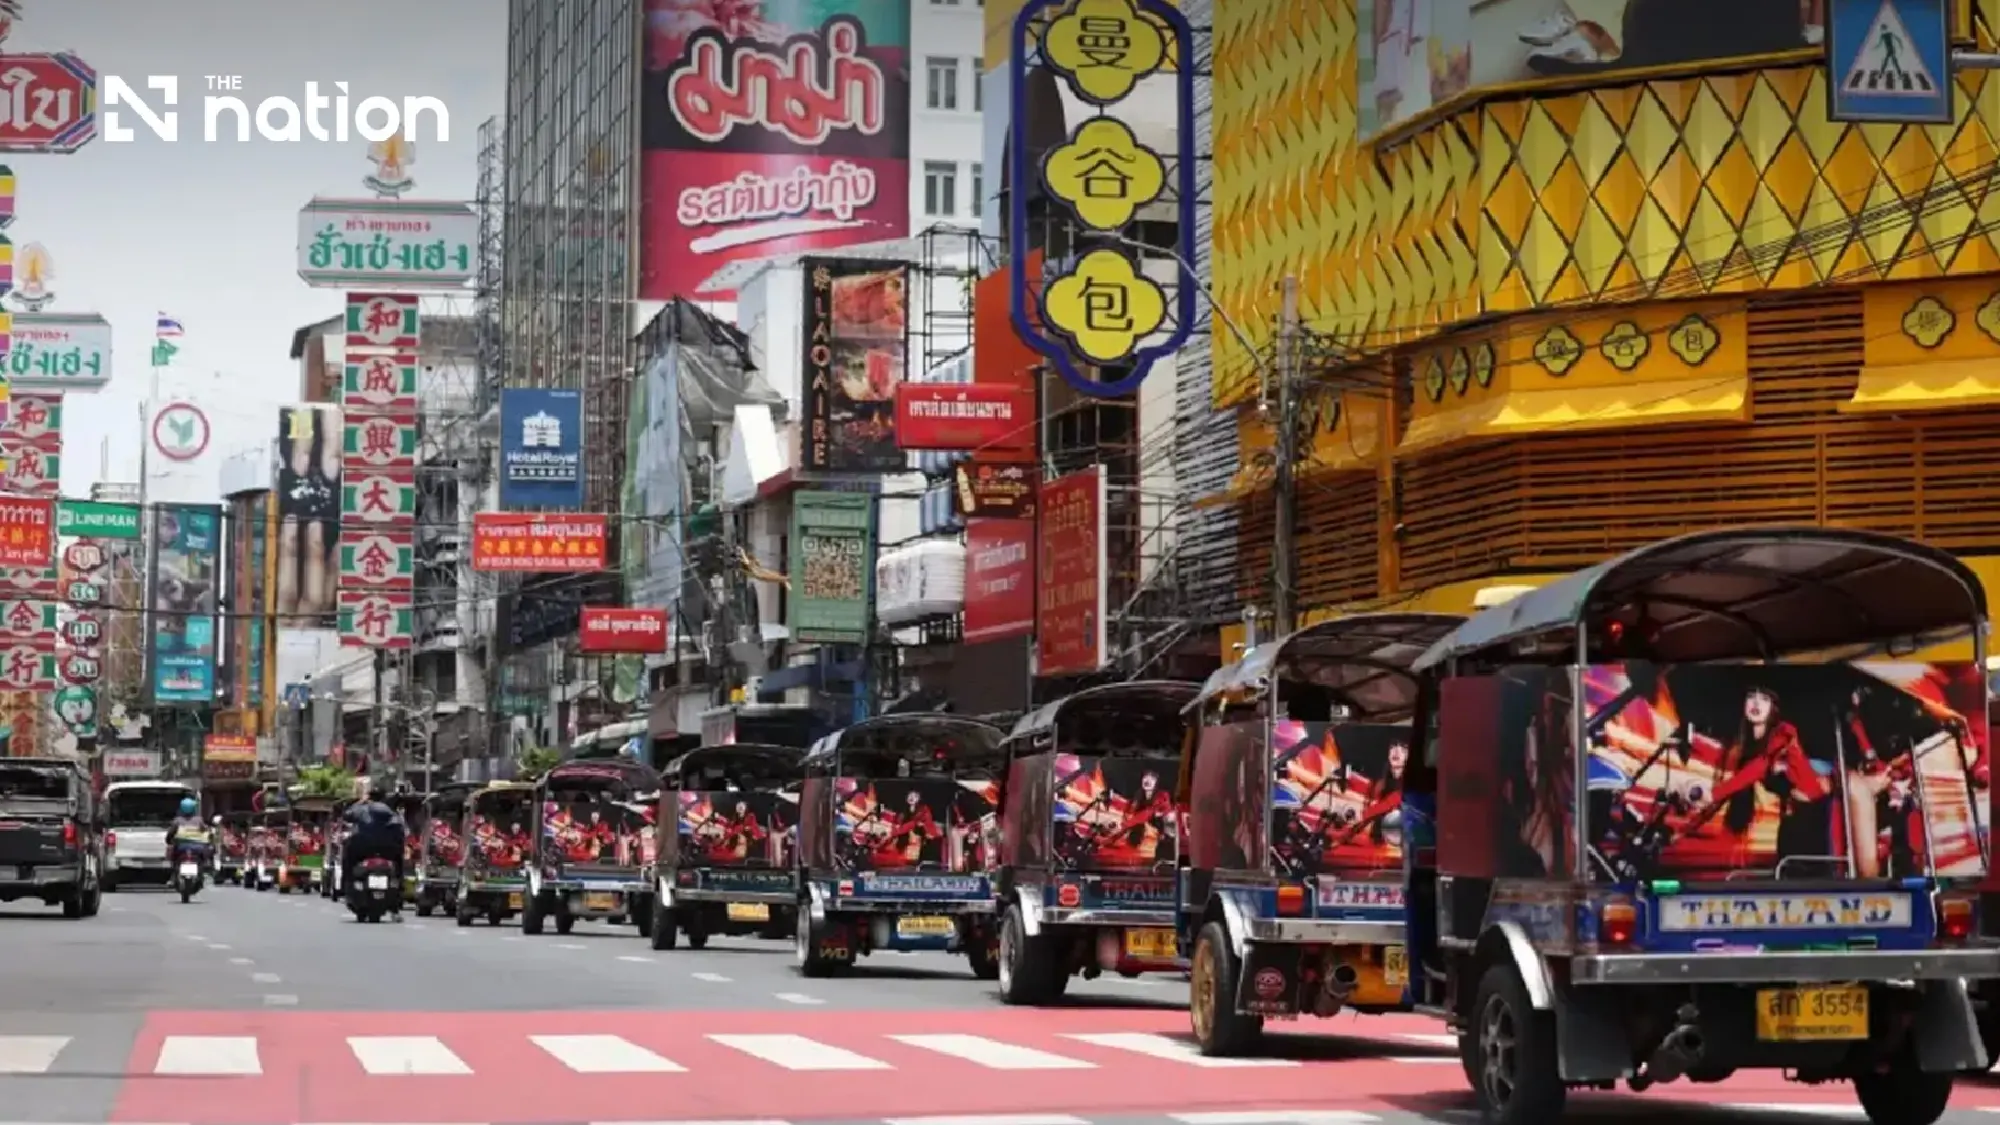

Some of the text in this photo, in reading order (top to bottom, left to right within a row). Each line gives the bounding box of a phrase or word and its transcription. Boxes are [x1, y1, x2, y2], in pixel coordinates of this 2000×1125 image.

[671, 22, 883, 143] มาม่า
[680, 163, 873, 222] รสต้มยำกุ้ง
[1075, 17, 1133, 331] 曼谷包
[355, 302, 400, 637] 和成興大金行
[106, 514, 136, 527] MAN
[1681, 897, 1894, 925] THAILAND
[1811, 991, 1864, 1017] 3554
